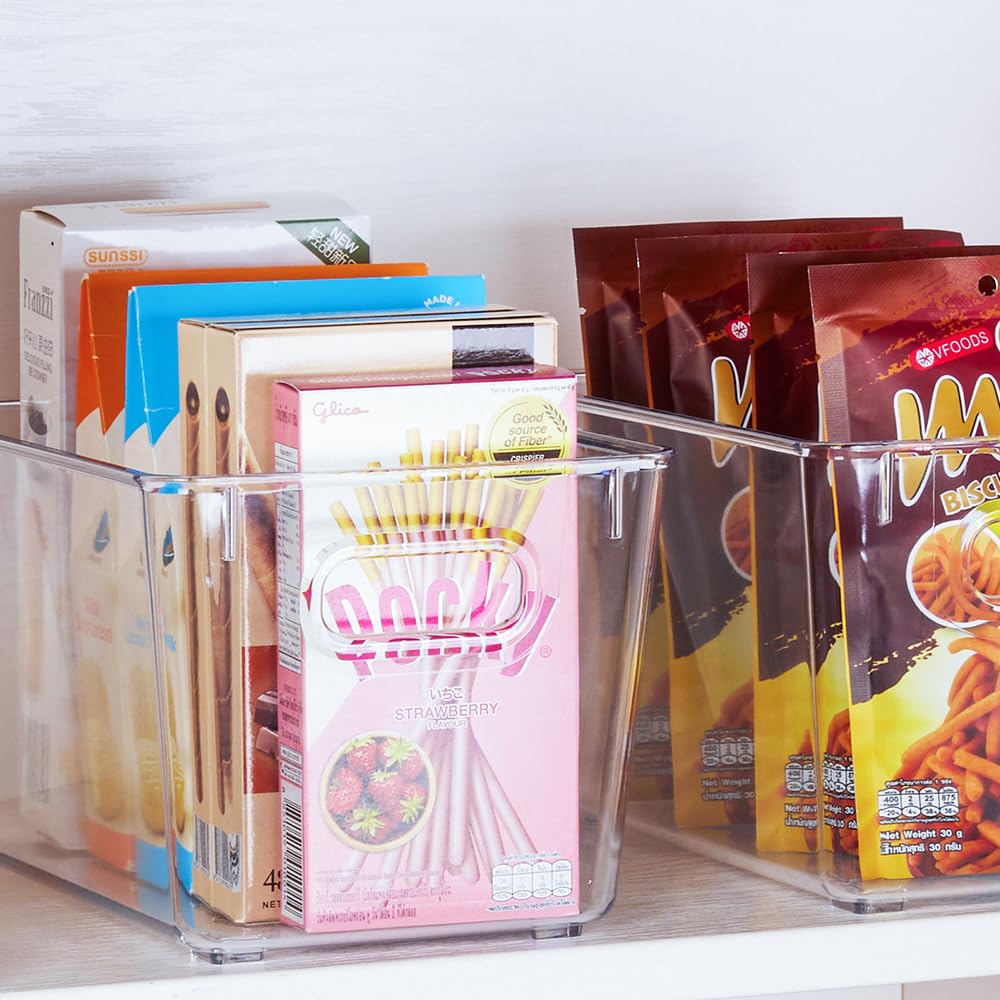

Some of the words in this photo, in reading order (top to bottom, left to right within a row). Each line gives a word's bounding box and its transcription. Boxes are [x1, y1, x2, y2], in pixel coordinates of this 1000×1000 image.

[330, 226, 359, 253] NEW
[934, 331, 989, 361] VFOODS
[312, 402, 370, 423] Glico
[513, 412, 544, 424] Good
[508, 425, 548, 436] source
[504, 436, 517, 447] of
[394, 702, 498, 721] STRAWBERRY
[880, 831, 900, 840] Net
[904, 830, 936, 840] Weight
[940, 829, 952, 837] 30
[929, 843, 941, 851] 30
